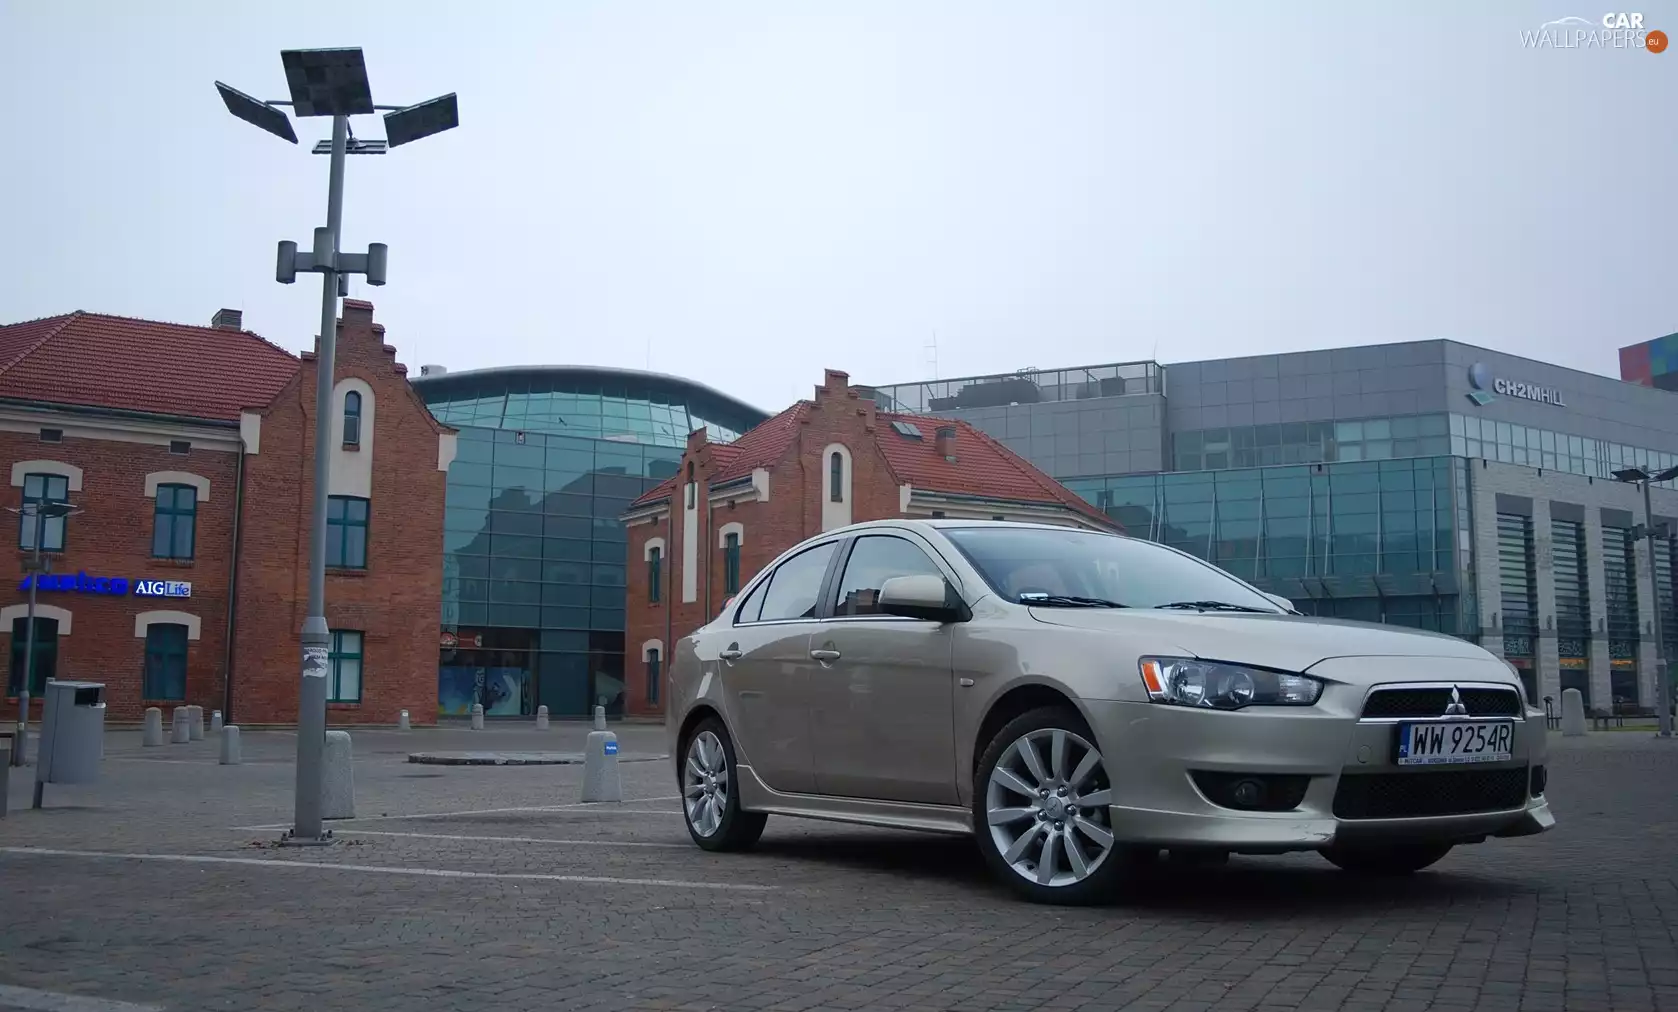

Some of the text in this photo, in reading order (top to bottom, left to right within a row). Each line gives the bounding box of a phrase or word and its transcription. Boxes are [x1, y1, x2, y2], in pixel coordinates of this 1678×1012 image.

[135, 581, 164, 595] AIG
[166, 583, 190, 596] Life
[1413, 724, 1511, 755] WW 9254R
